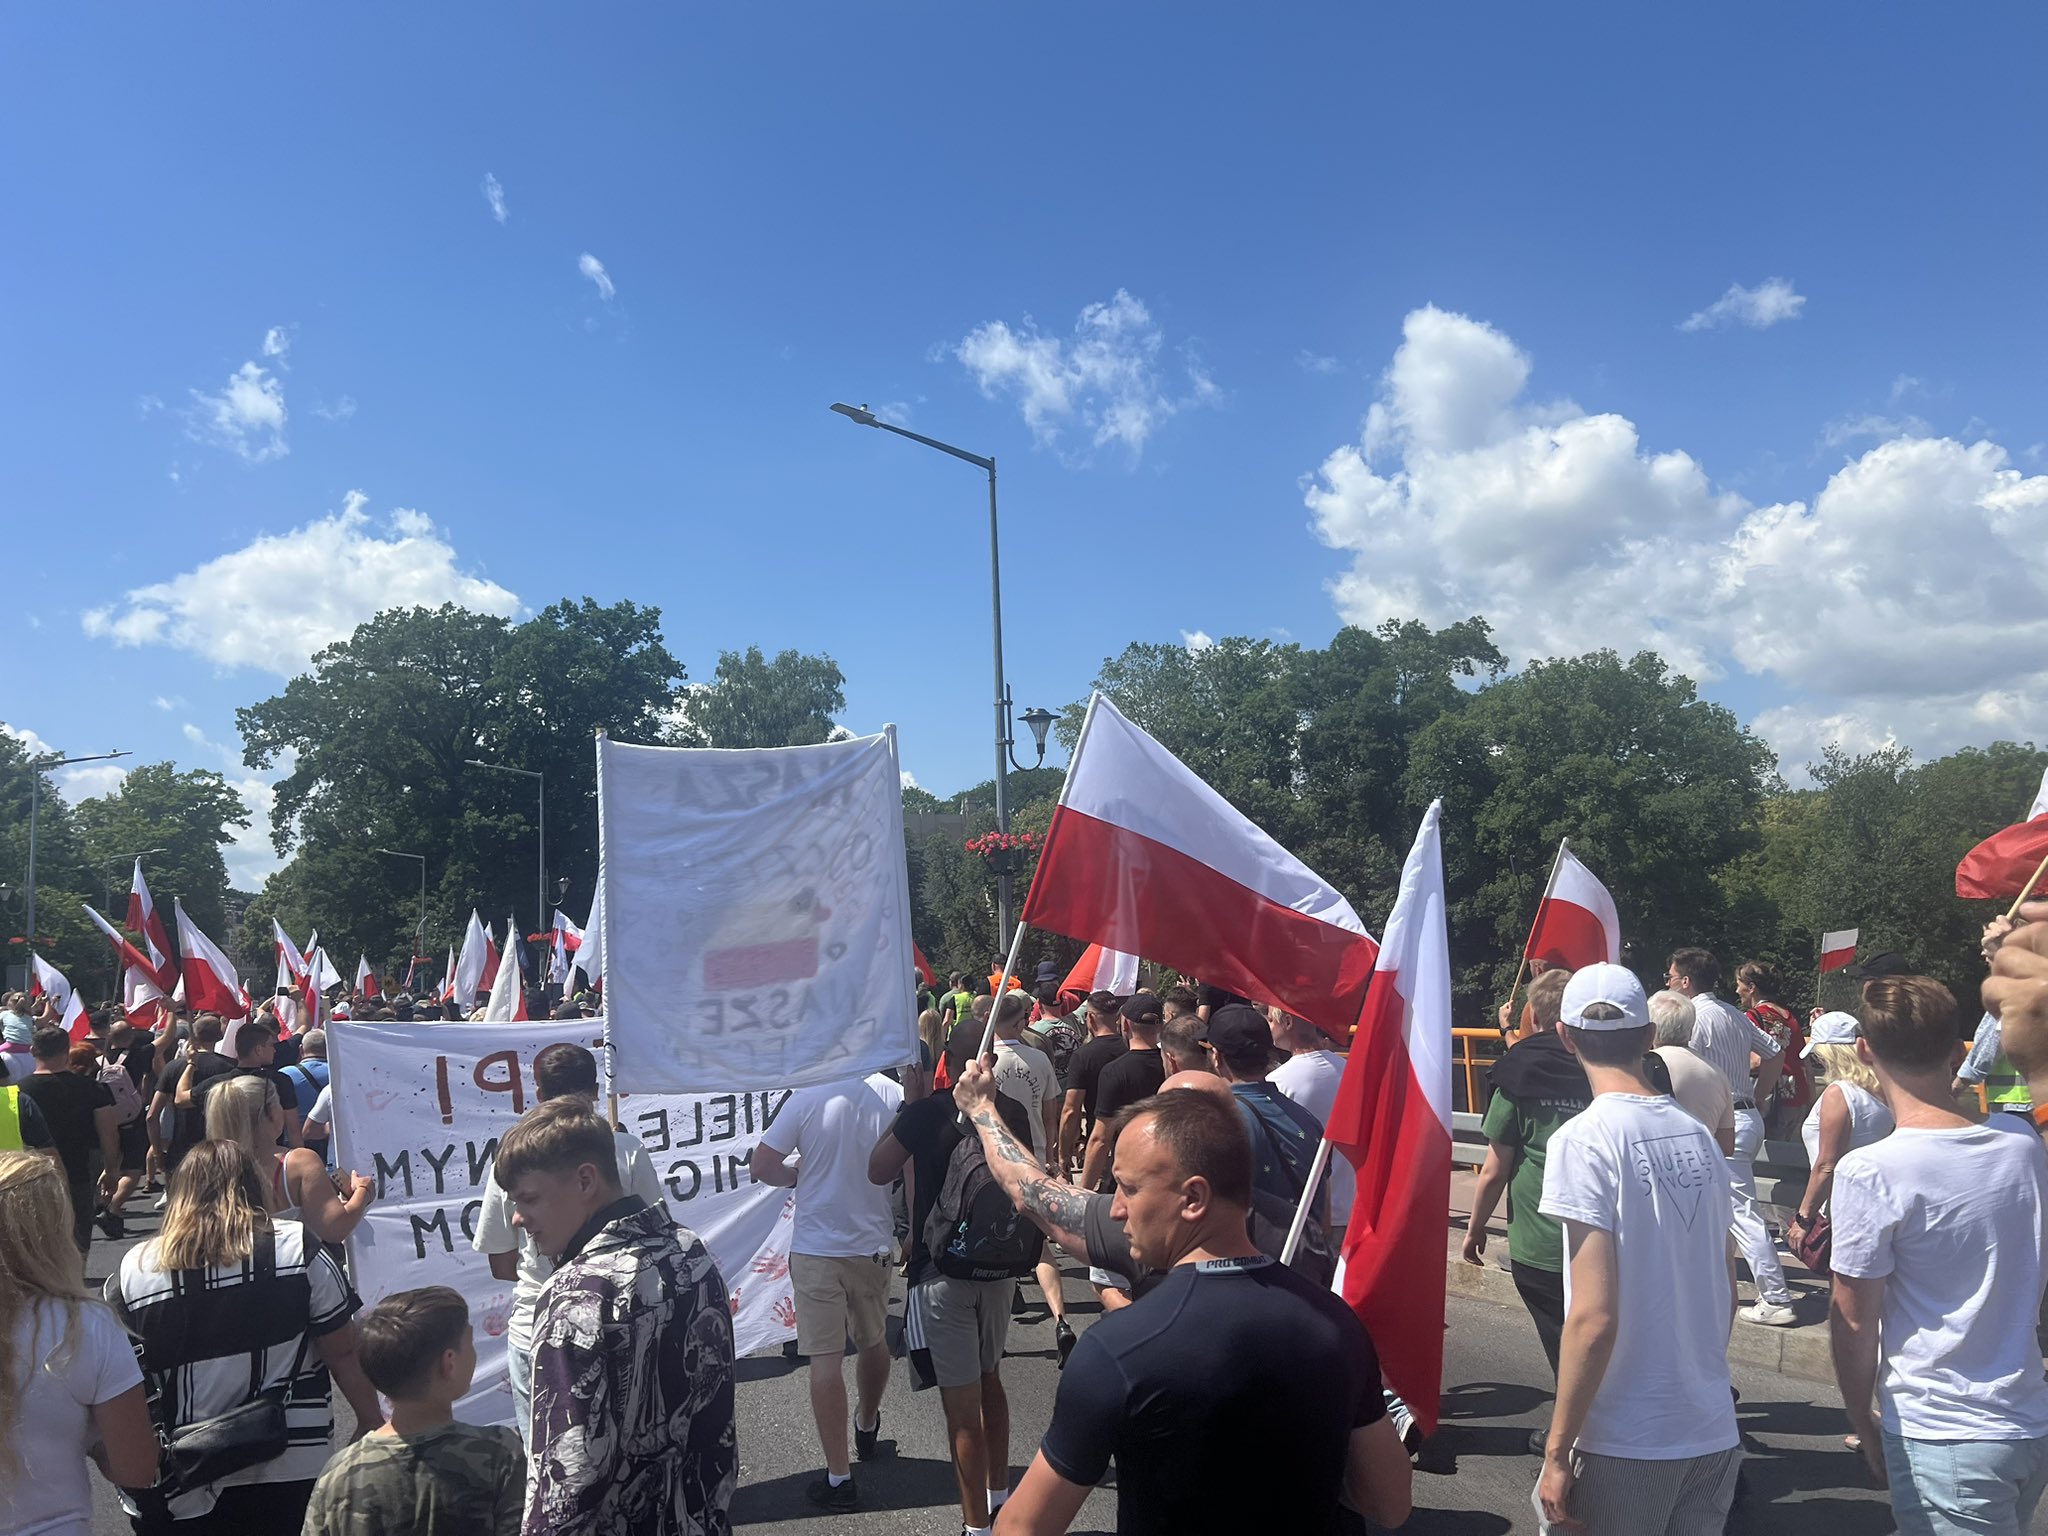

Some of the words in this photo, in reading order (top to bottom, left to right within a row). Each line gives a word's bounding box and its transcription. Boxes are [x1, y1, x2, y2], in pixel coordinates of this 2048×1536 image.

[1637, 1148, 1712, 1177] SHUFFLE
[1206, 1259, 1230, 1269] PRO
[1233, 1255, 1267, 1267] COMBAT
[971, 1267, 1010, 1278] FORTNITE
